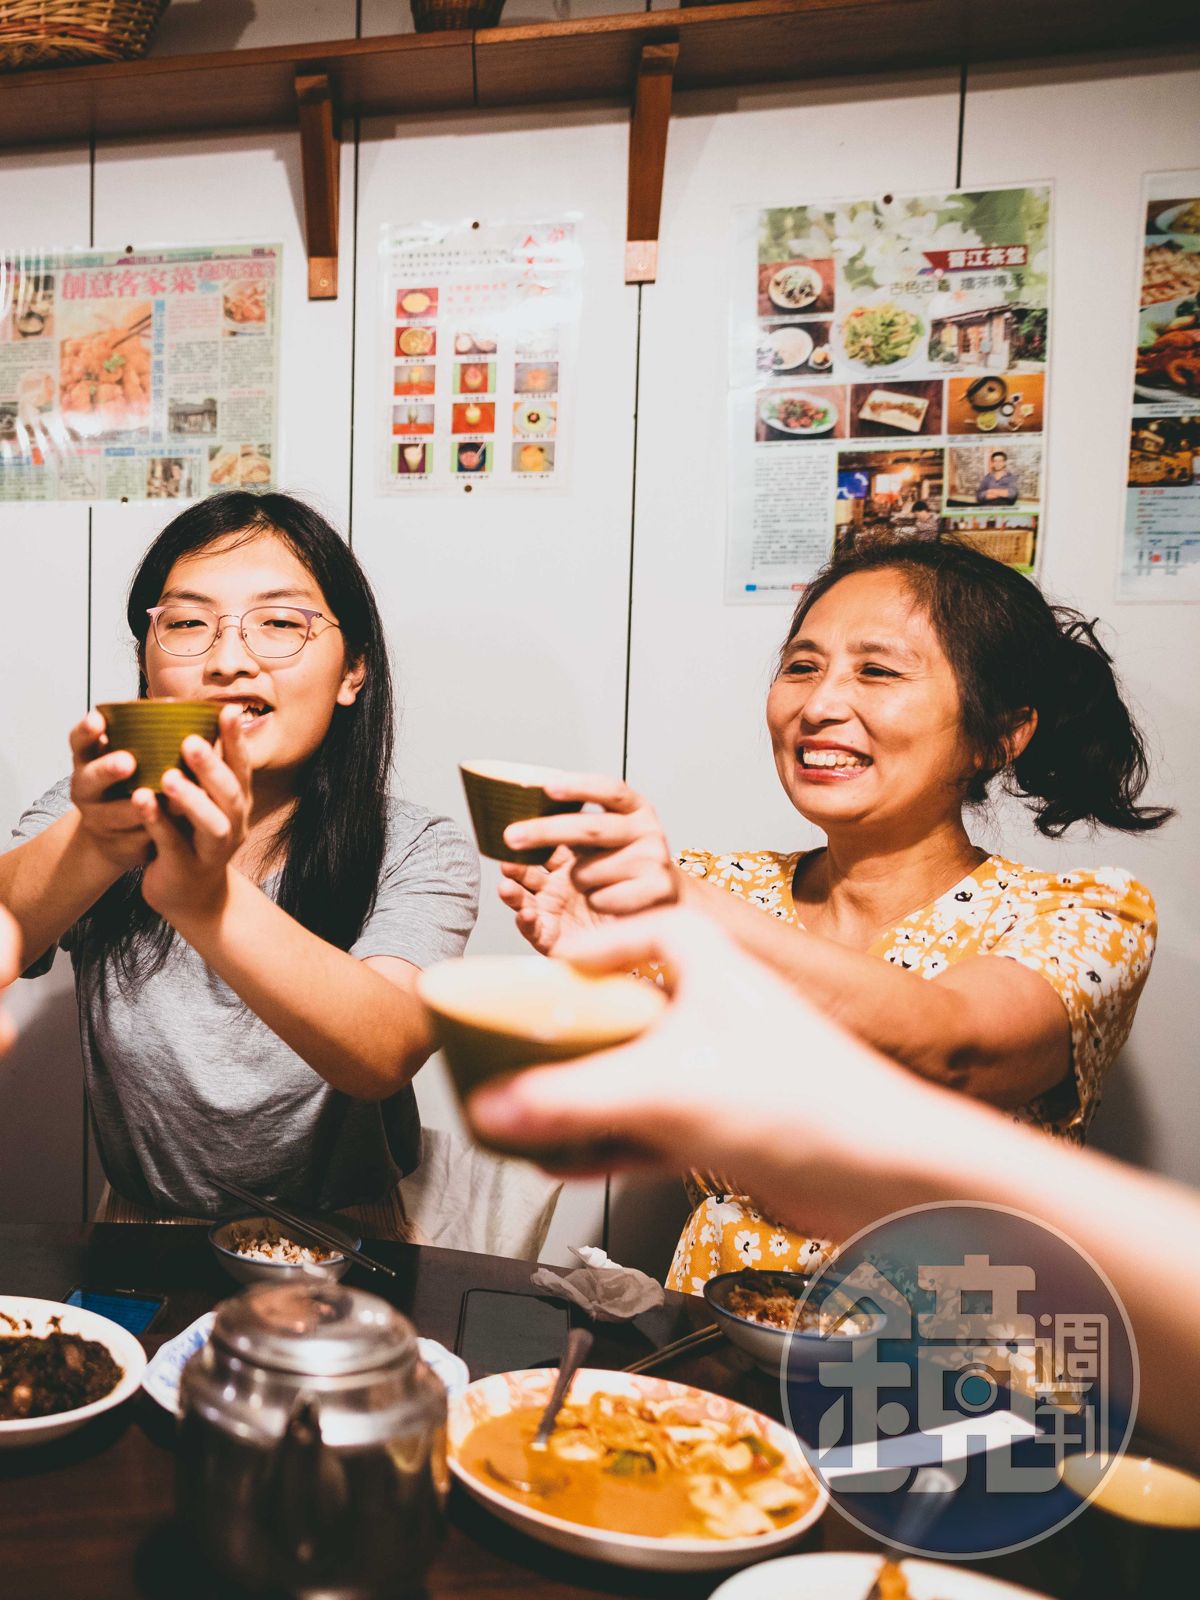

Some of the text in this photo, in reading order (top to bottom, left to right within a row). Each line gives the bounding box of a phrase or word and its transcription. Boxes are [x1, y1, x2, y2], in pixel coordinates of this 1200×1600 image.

[947, 246, 1026, 269] 晉江茶堂
[62, 267, 197, 300] 創意客家菜
